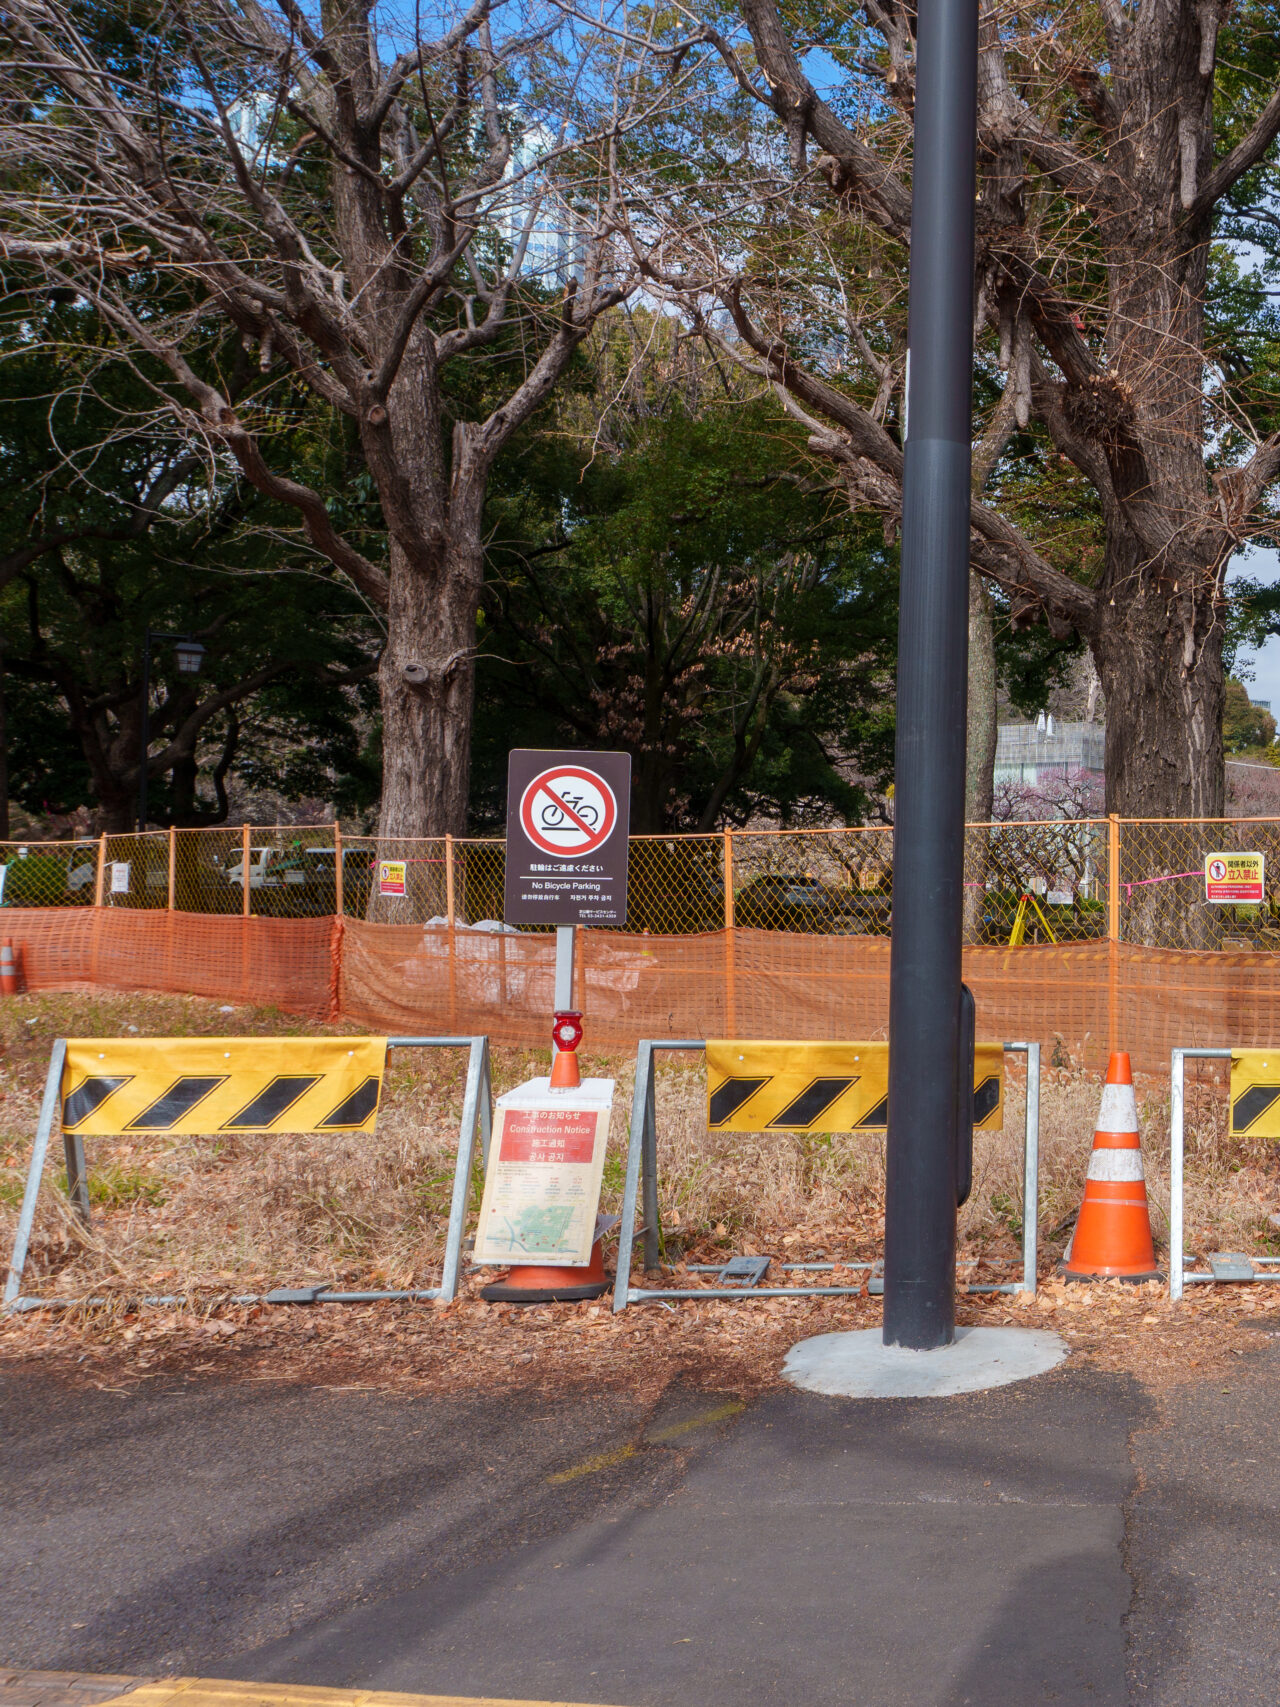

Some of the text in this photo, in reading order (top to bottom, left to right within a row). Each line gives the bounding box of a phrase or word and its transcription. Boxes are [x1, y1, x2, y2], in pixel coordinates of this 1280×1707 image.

[529, 863, 604, 872] 駐輪はご遠慮ください
[1228, 869, 1259, 881] 立入禁止
[544, 882, 571, 891] Bicycle
[572, 882, 601, 891] Parking
[523, 1111, 582, 1120] 工事のお知らせ
[510, 1124, 591, 1134] Construction Notice
[529, 1152, 545, 1161] 공사
